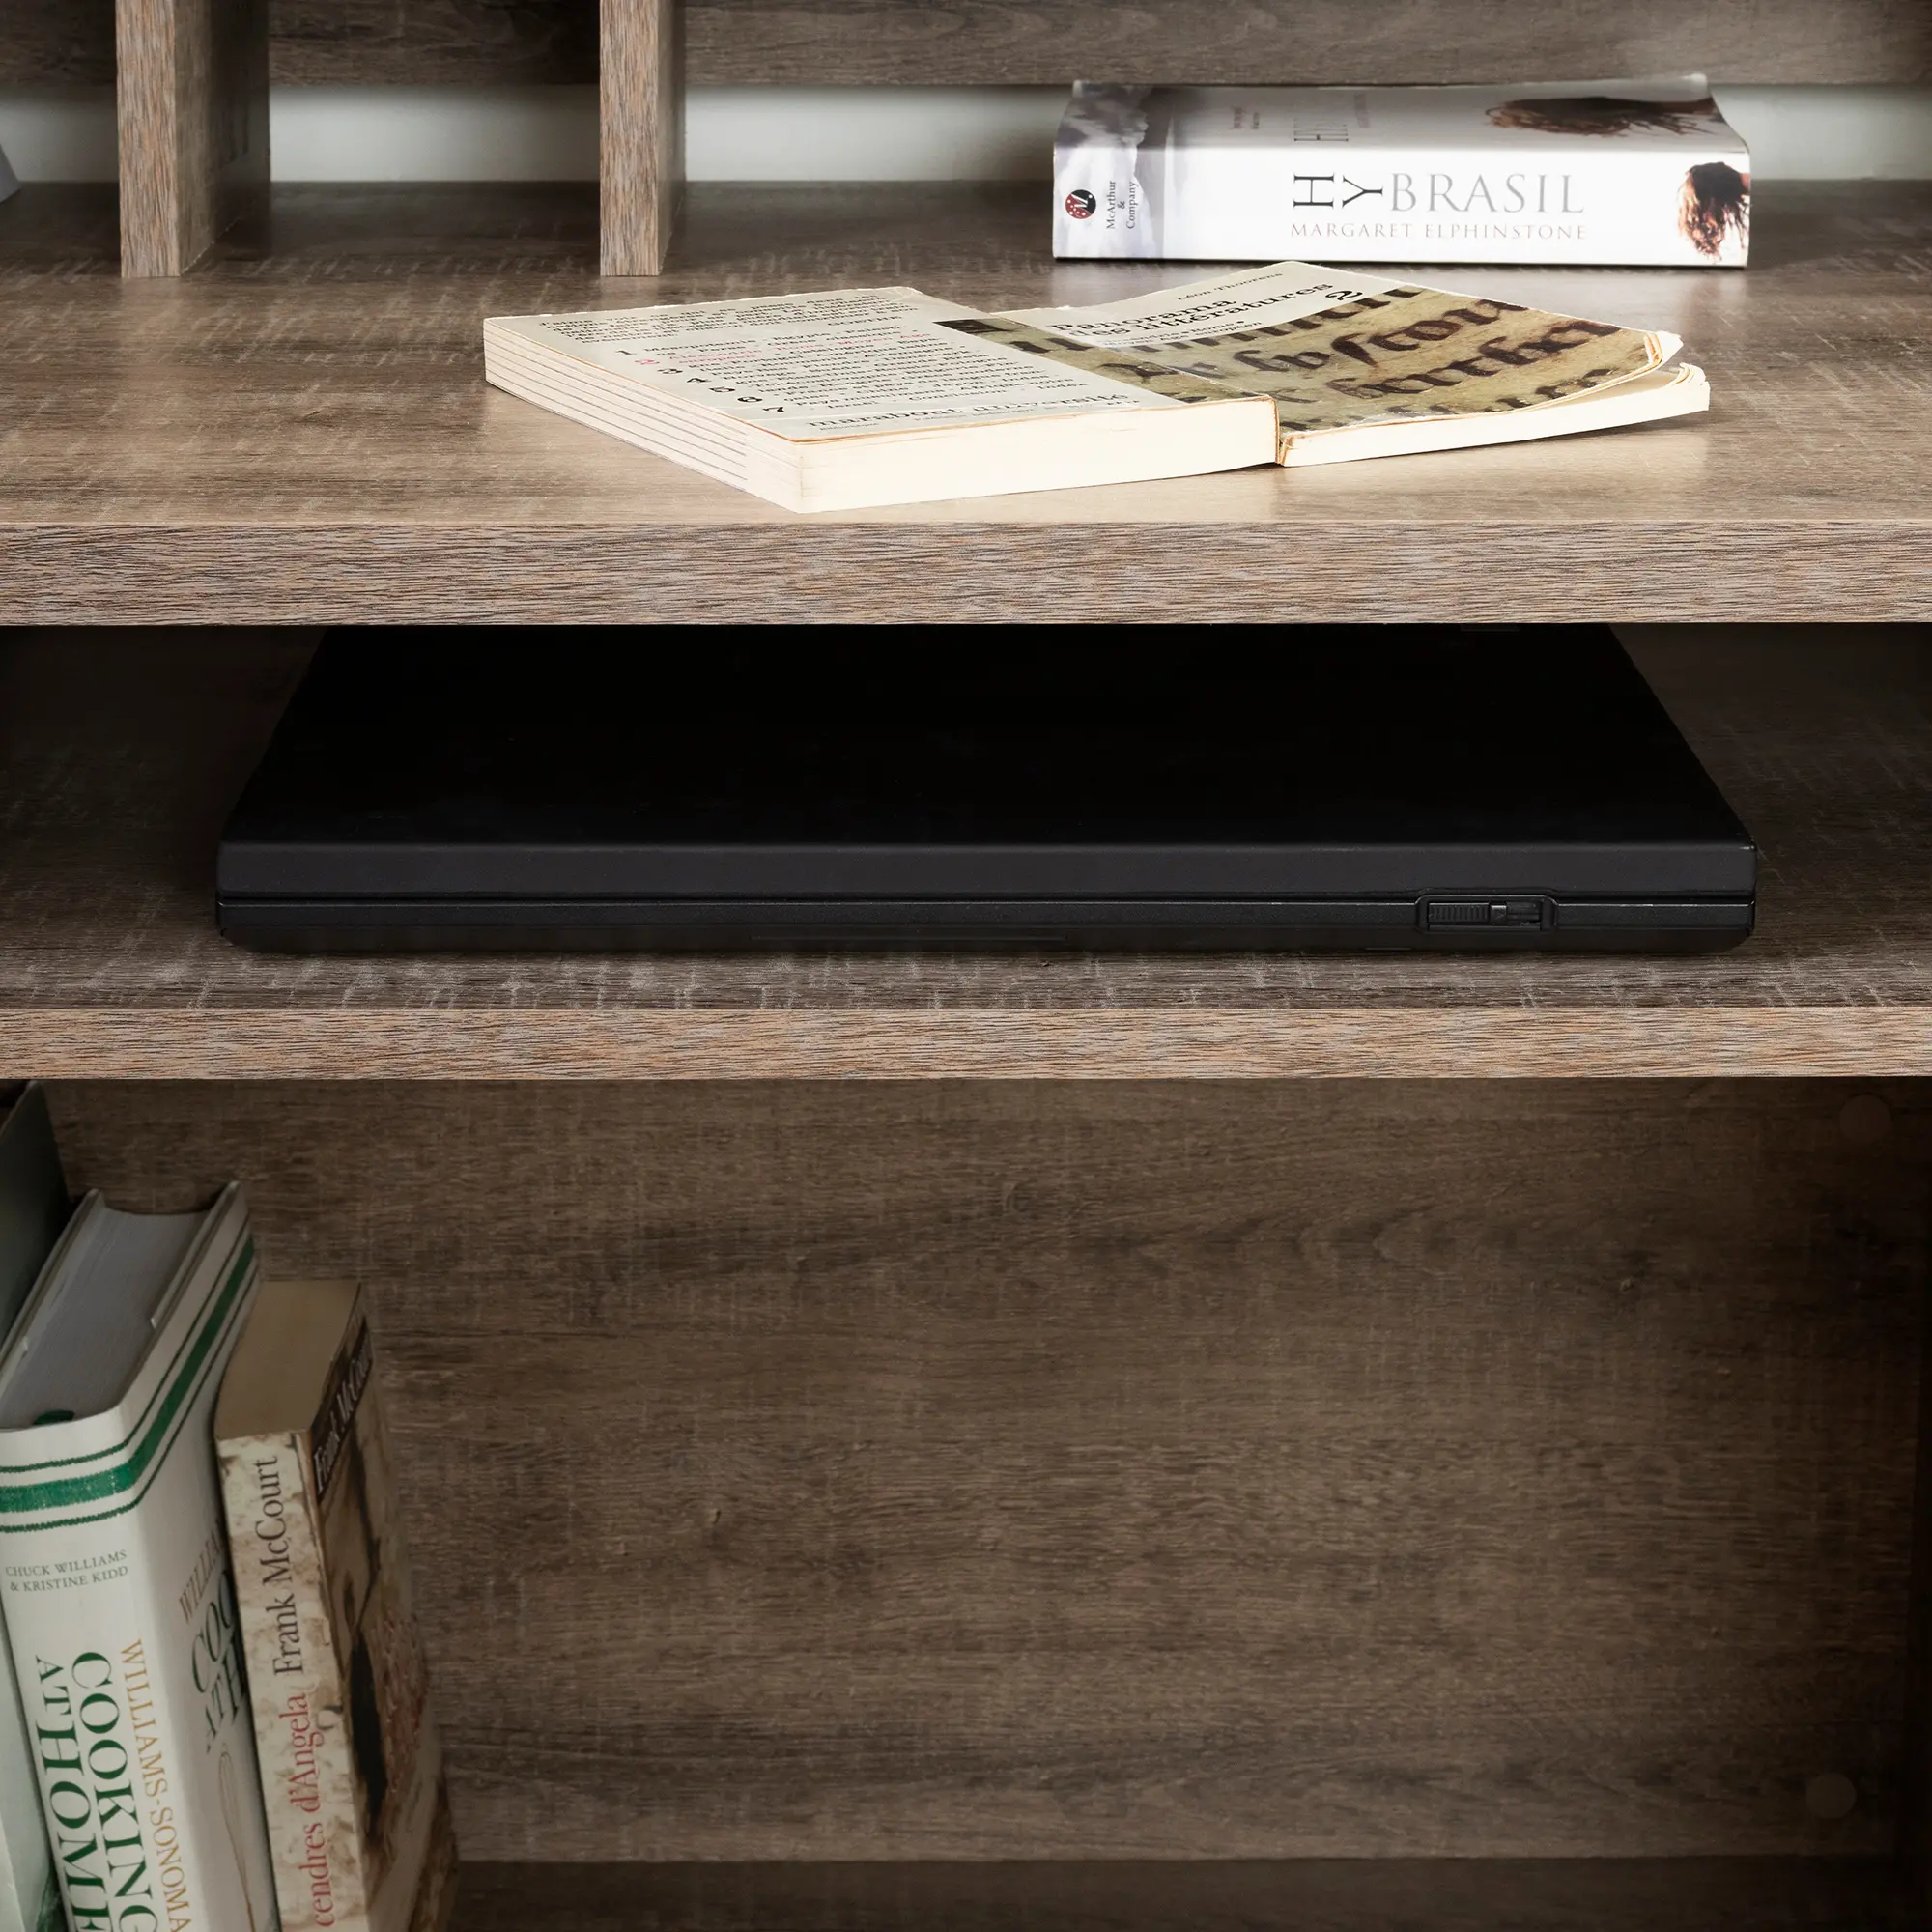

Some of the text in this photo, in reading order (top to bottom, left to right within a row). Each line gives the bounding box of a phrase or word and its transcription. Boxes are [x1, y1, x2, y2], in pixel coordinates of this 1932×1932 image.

[1106, 181, 1116, 229] McArthur
[1126, 182, 1139, 229] Company
[1391, 172, 1584, 213] BRASIL
[1291, 222, 1586, 240] MARGARET ELPHINSTONE
[1049, 298, 1236, 331] Panorama
[1137, 283, 1334, 331] littératures
[1324, 290, 1363, 301] 2
[5, 1549, 127, 1577] CHUCK WILLIAMS
[10, 1566, 128, 1592] & KRISTINE KIDD
[252, 1455, 304, 1676] Frank McCourt
[35, 1655, 73, 1716] AT
[71, 1652, 157, 1932] COOKING
[120, 1638, 192, 1932] WILLIAMS-SONOMA
[278, 1692, 335, 1927] cendres d'Angela
